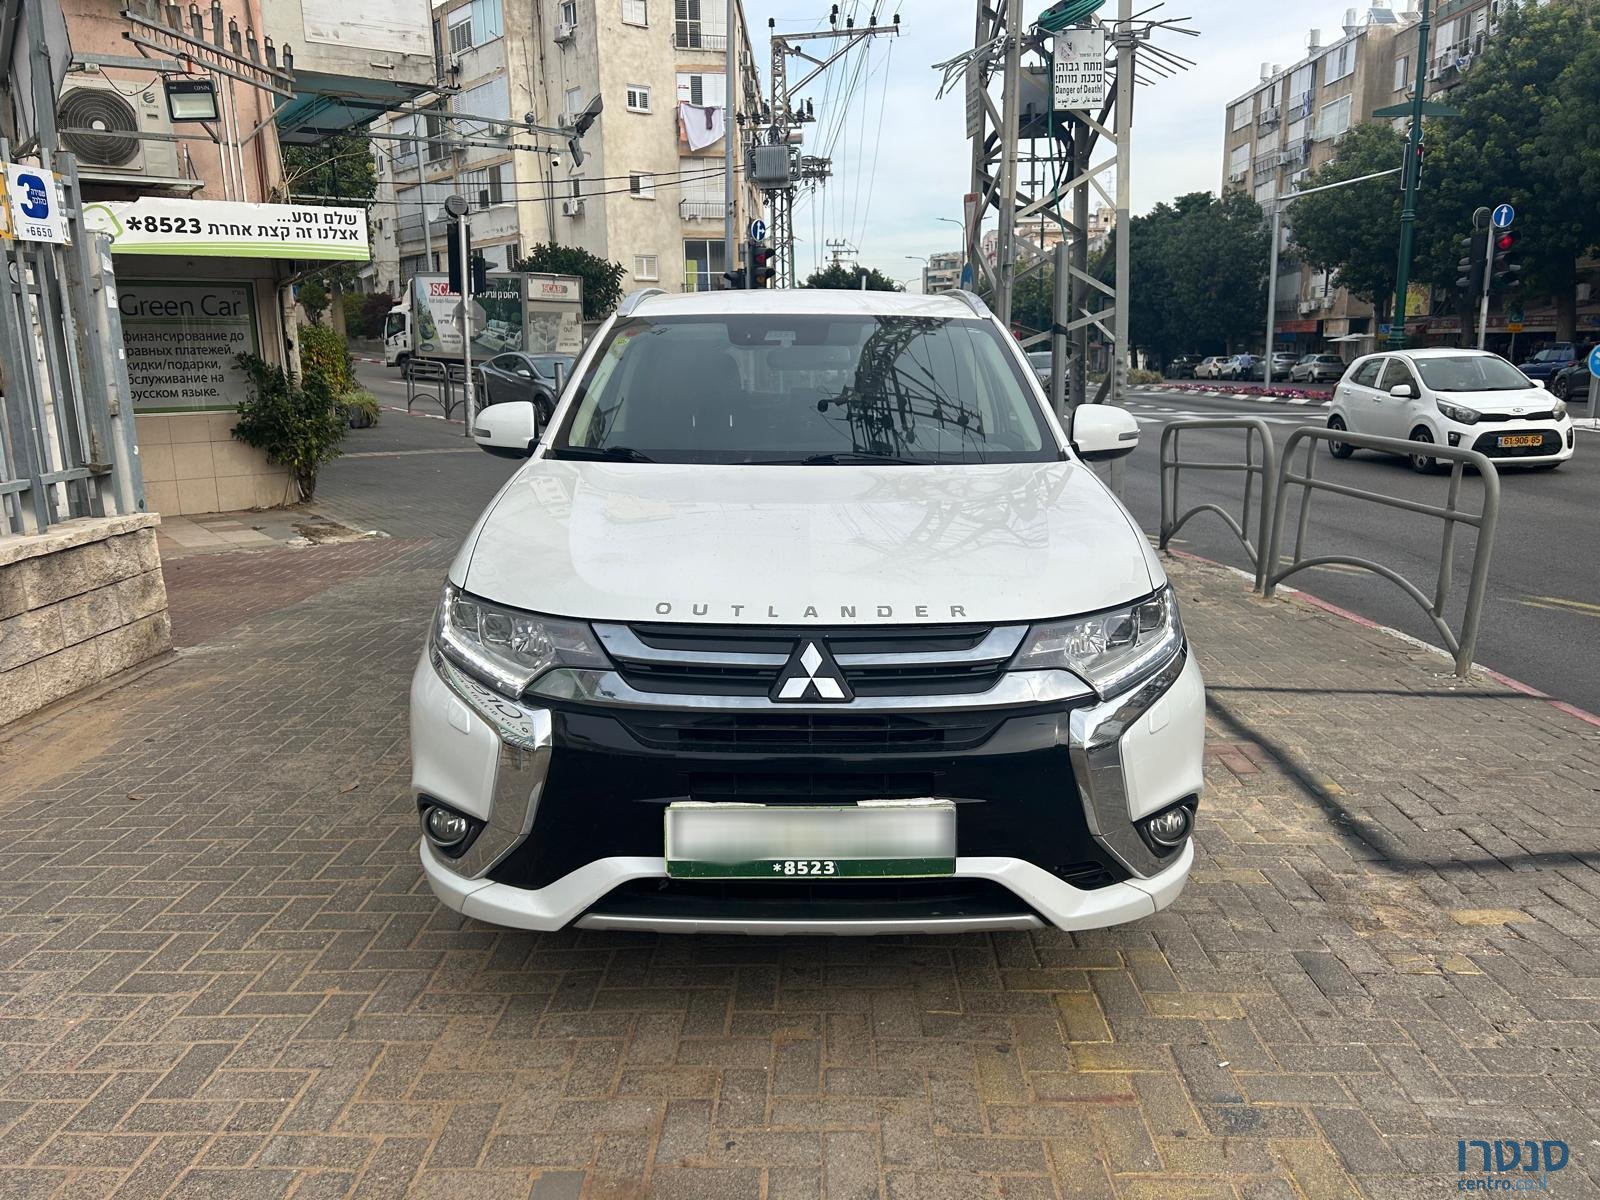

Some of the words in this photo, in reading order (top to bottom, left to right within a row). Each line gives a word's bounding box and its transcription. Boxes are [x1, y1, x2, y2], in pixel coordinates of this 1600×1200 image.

[1056, 62, 1080, 72] גבוה!
[1083, 62, 1102, 71] מתח
[1055, 74, 1078, 84] מוות!
[1081, 74, 1102, 83] סכנת
[1055, 85, 1076, 96] Danger
[1077, 85, 1083, 94] of
[1083, 85, 1103, 94] Death!
[277, 211, 319, 224] וסע...
[324, 211, 357, 226] שלם
[208, 223, 252, 236] אחרת
[257, 225, 290, 241] קצת
[296, 227, 312, 239] זה
[318, 226, 359, 240] אצלנו
[432, 283, 460, 296] SC
[118, 294, 194, 317] Green
[200, 294, 241, 317] Car
[123, 331, 228, 345] финансирование
[229, 331, 244, 343] до
[127, 347, 172, 359] равных
[174, 344, 235, 356] платежей.
[210, 374, 224, 383] на
[181, 386, 220, 398] языке.
[655, 602, 967, 619] OUTLANDER
